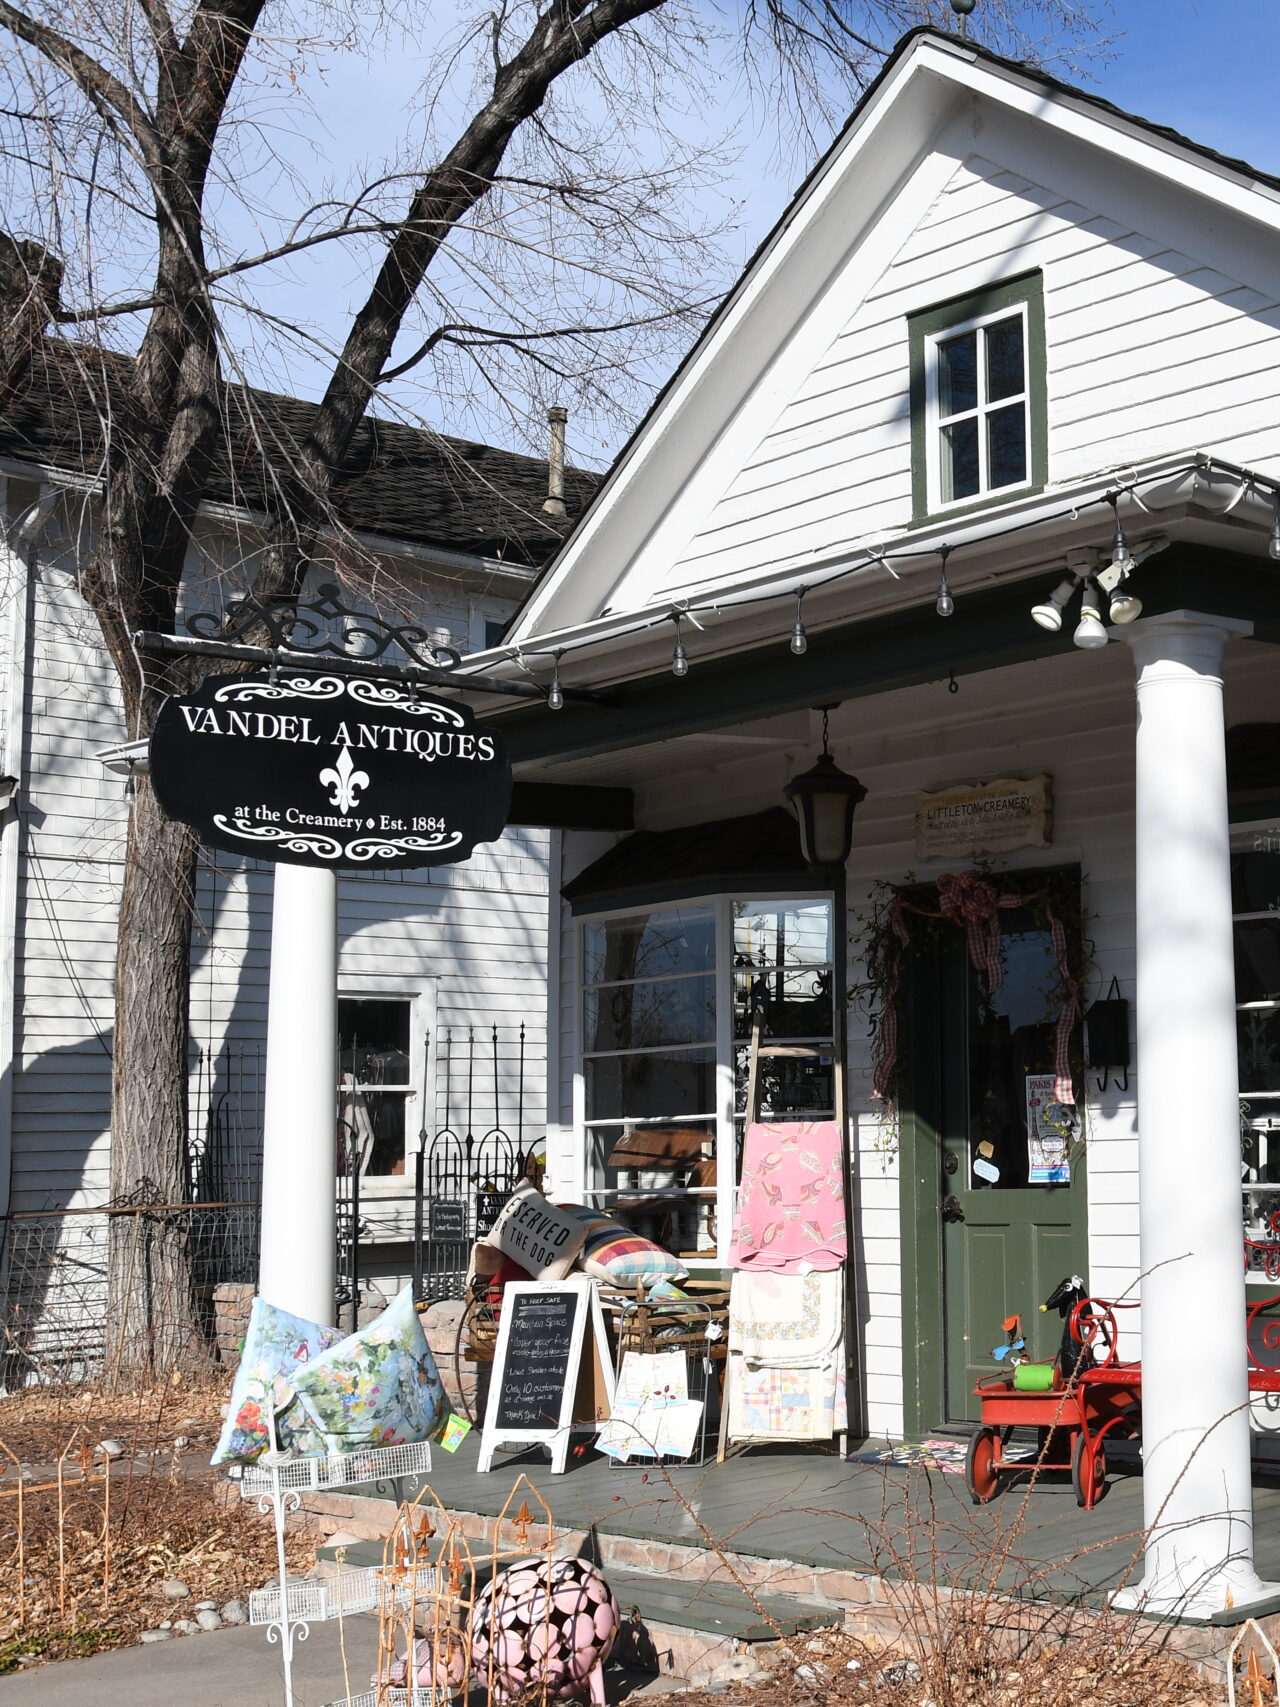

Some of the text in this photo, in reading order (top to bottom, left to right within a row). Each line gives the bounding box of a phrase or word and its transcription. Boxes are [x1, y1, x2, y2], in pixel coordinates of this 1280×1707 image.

[179, 704, 495, 762] VANDEL ANTIQUES
[234, 804, 446, 832] at the Creamery Est. 1884
[927, 802, 980, 820] LITTLETON
[984, 796, 1032, 813] CREAMERY
[478, 1219, 495, 1231] Sho
[506, 1197, 570, 1247] ESERVED
[510, 1227, 529, 1252] THE
[530, 1243, 555, 1268] DOG
[544, 1296, 561, 1304] SAFE
[545, 1316, 568, 1329] Space
[505, 1383, 522, 1396] Only
[523, 1382, 533, 1394] 10
